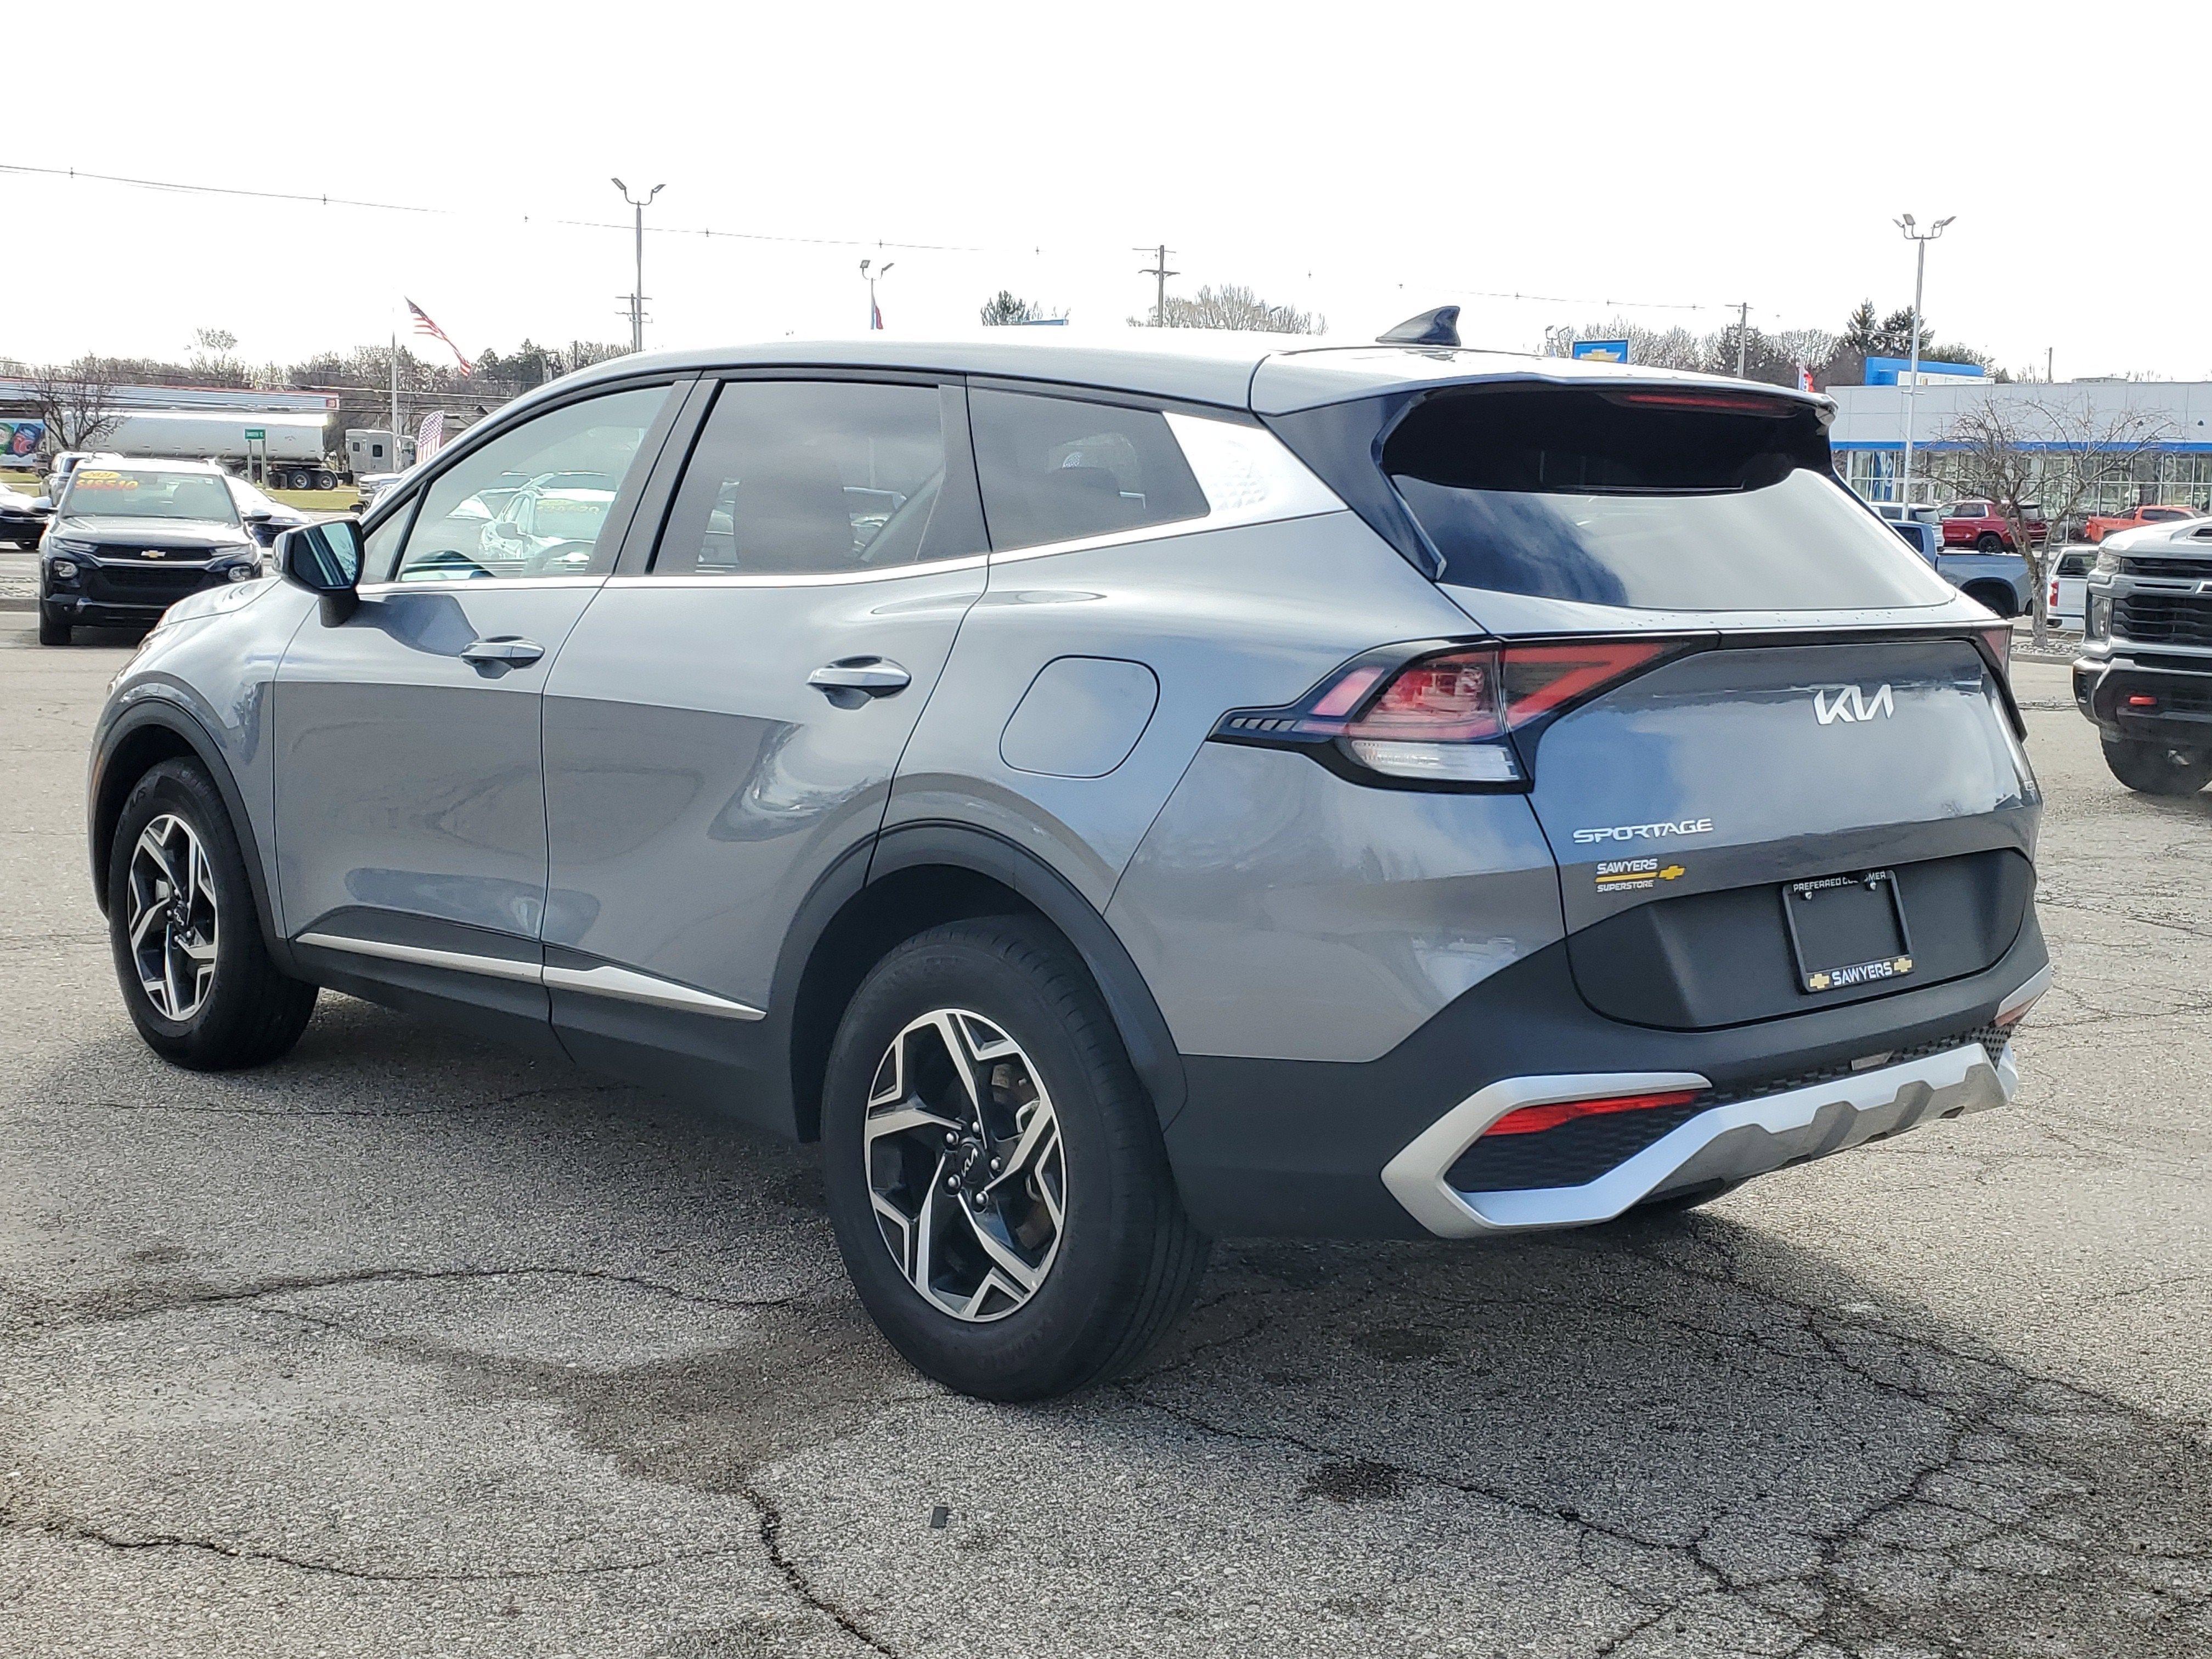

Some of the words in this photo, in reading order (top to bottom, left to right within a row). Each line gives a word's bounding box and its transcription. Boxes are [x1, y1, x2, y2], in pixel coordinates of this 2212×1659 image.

[1813, 684, 1894, 725] KIA
[1573, 818, 1714, 844] SPORTAGE
[1596, 858, 1658, 875] SAWYERS
[1596, 879, 1655, 893] SUPERSTORE
[1793, 877, 1842, 892] PREFERRED
[1842, 870, 1886, 885] CMER
[1831, 961, 1893, 986] SAWYERS
